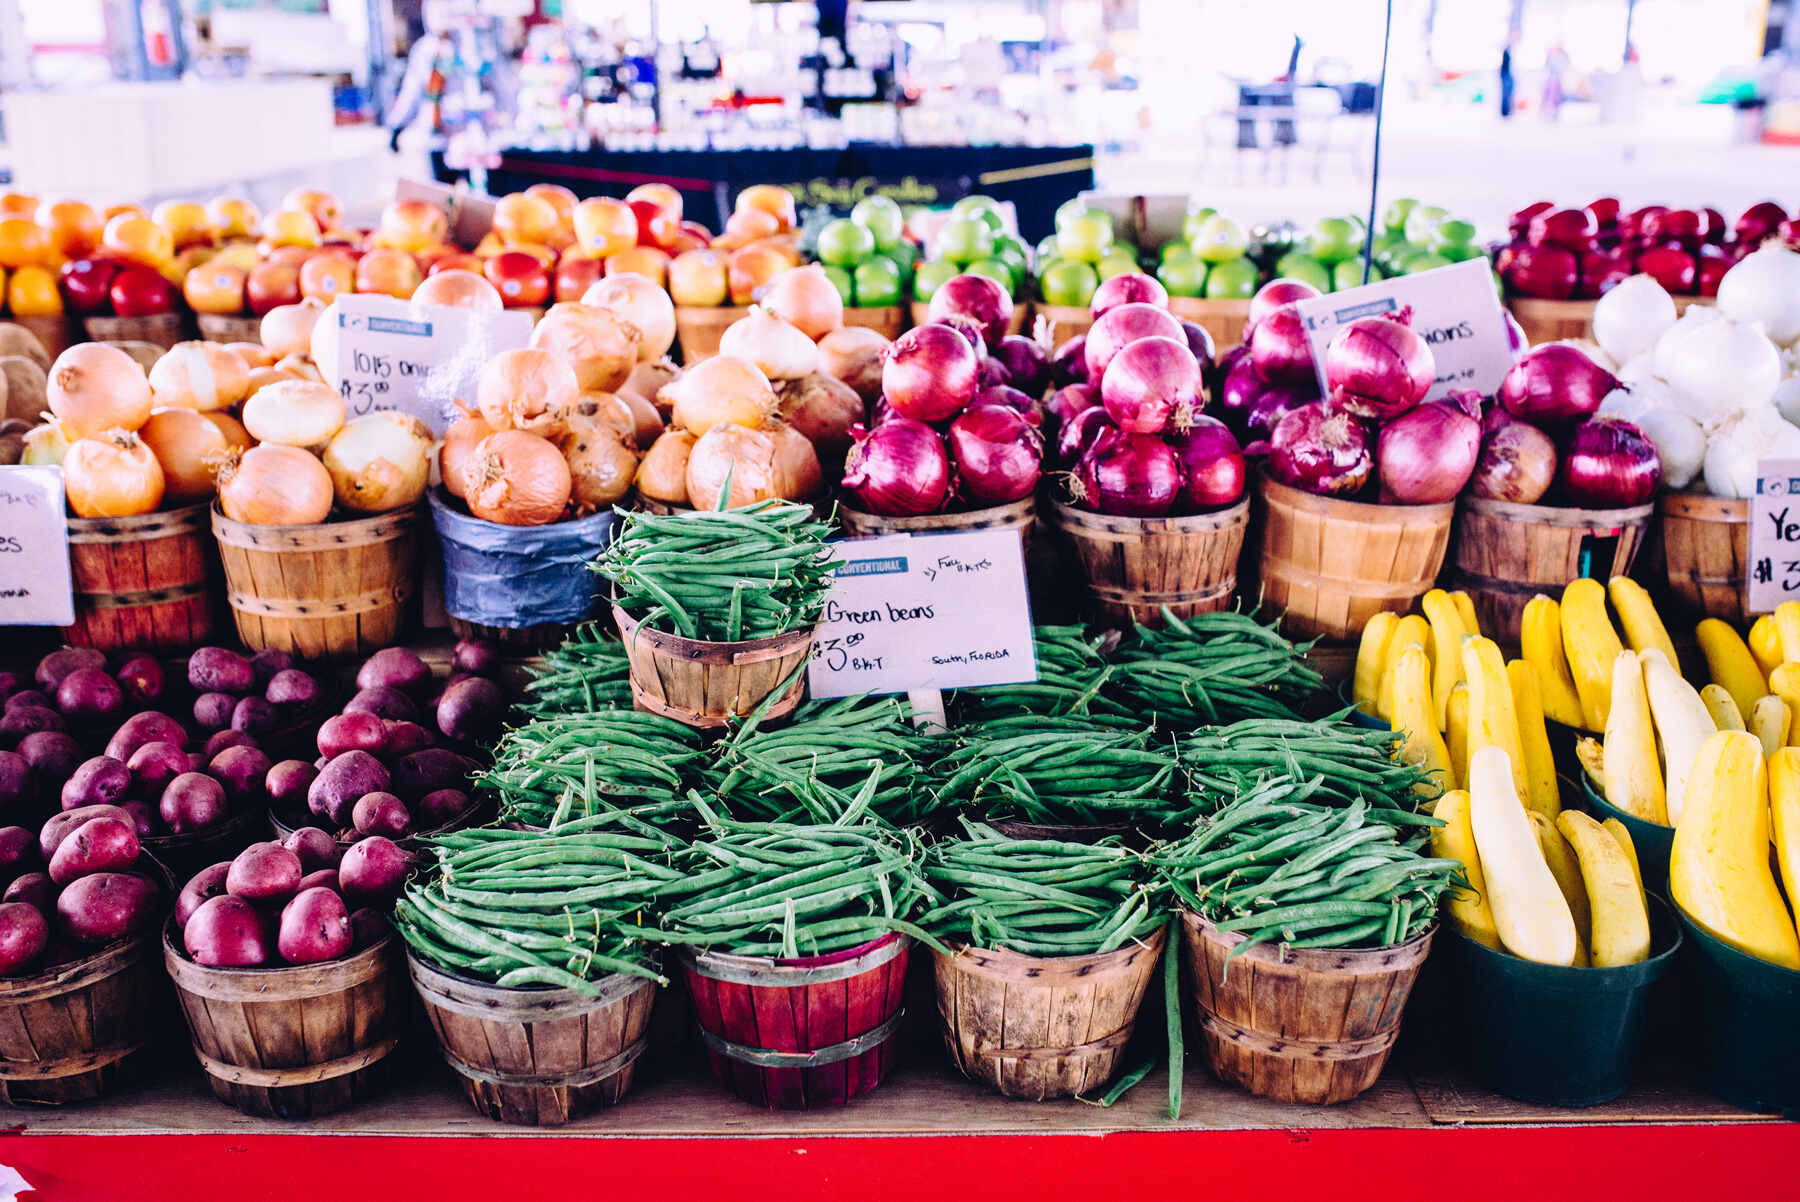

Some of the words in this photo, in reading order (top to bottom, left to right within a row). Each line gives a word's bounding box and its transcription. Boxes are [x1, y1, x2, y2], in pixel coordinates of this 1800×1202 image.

[838, 560, 902, 576] CONVENTIONAL
[827, 600, 881, 624] Green
[886, 603, 935, 623] beans
